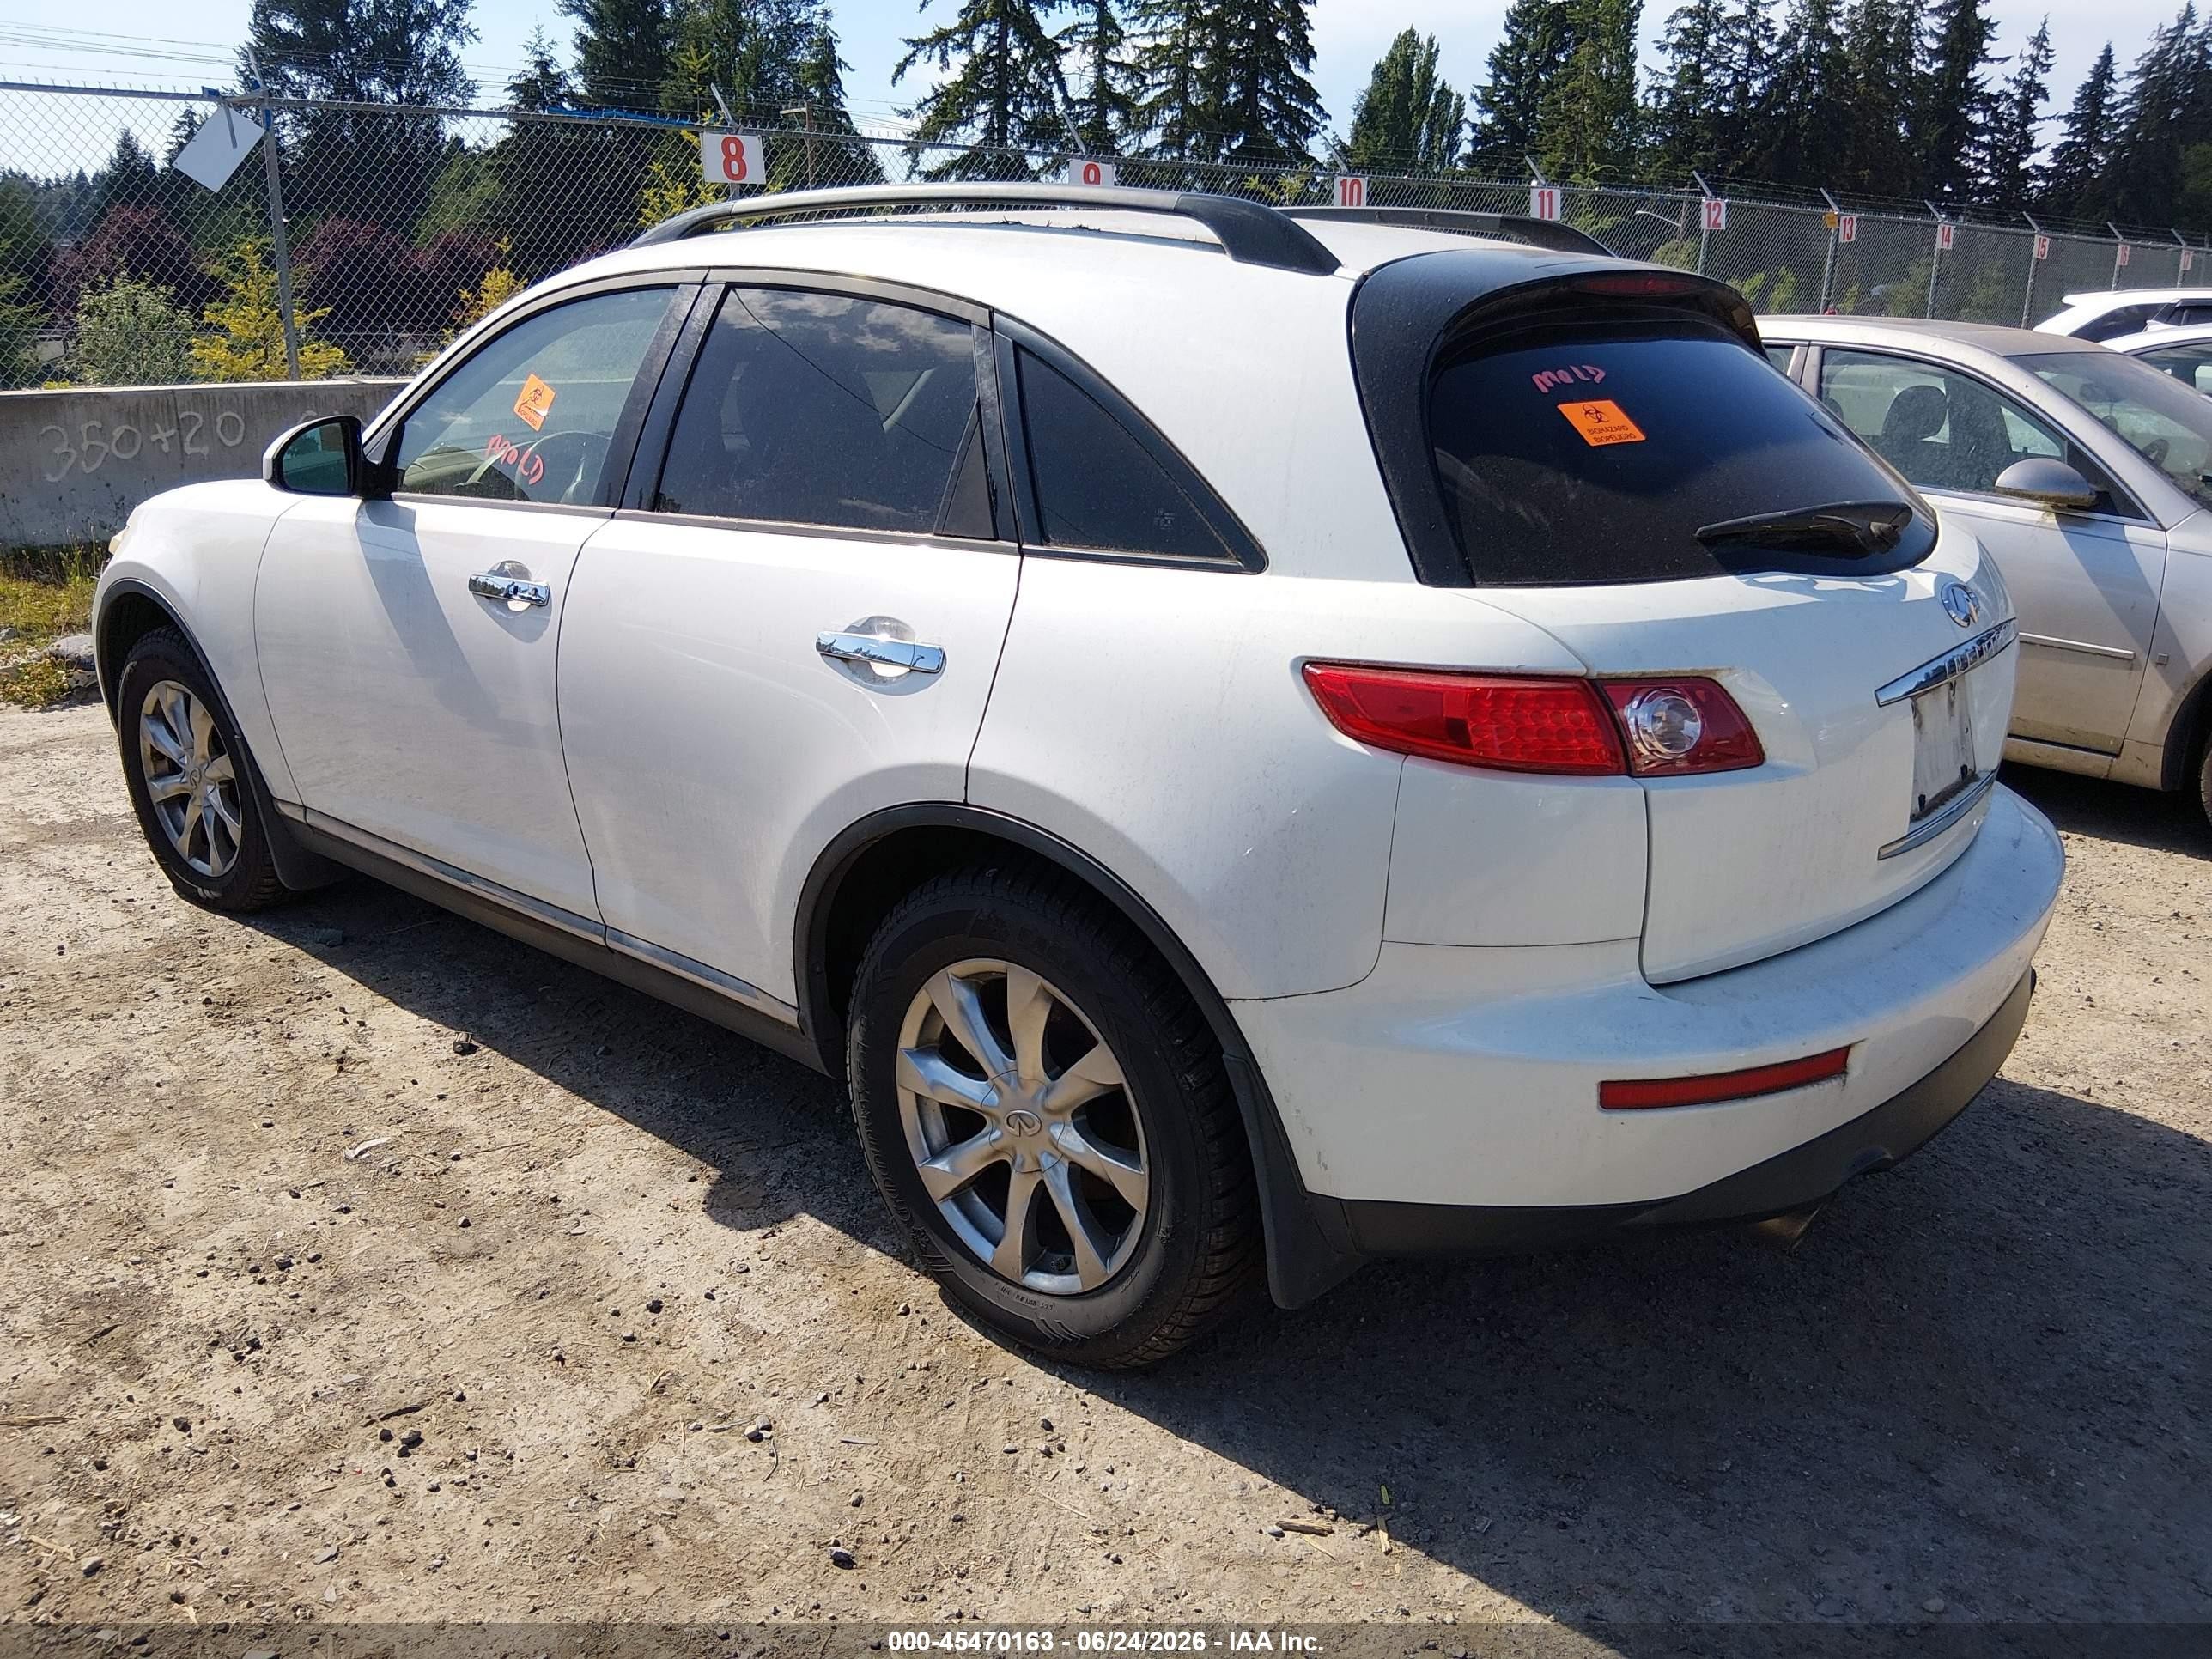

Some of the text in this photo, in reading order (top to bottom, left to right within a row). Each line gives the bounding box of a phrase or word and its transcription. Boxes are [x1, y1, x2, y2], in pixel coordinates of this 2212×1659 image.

[721, 136, 747, 181] 8
[1340, 178, 1362, 206] 10
[1538, 190, 1553, 220] 11
[1705, 202, 1722, 228] 12
[1843, 216, 1854, 241] 13
[1941, 225, 1952, 248] 14
[2036, 236, 2047, 258] 15
